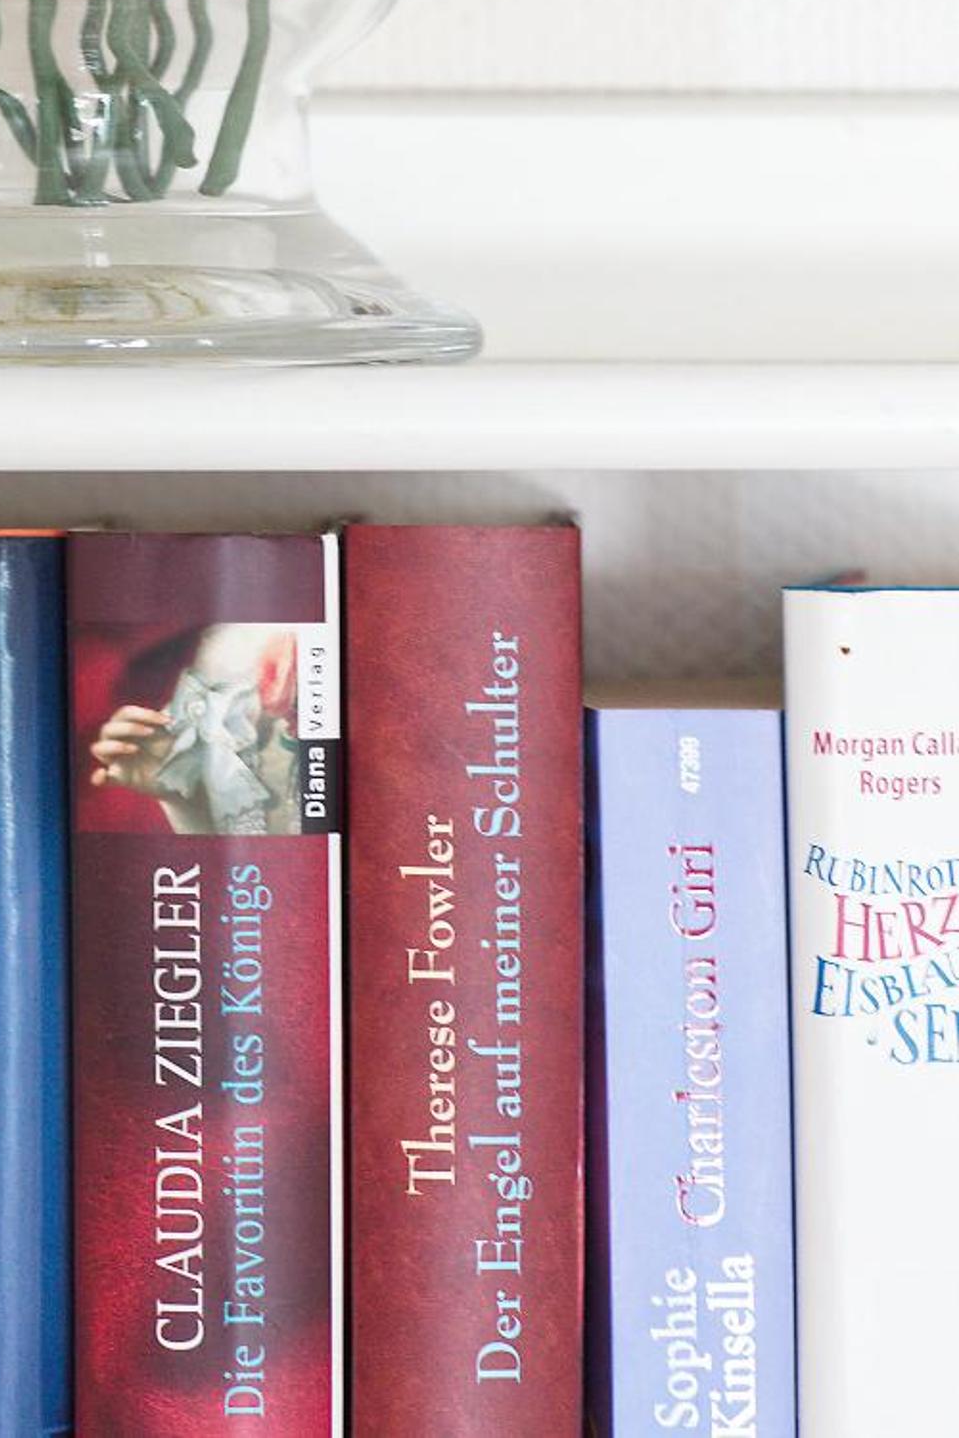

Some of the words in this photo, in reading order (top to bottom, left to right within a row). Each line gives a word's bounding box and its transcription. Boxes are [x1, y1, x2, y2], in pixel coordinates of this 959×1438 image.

[307, 646, 326, 731] Verlag
[464, 631, 523, 837] Schulter
[814, 731, 905, 761] Morgan
[912, 731, 959, 756] Call
[304, 745, 327, 819] Diana
[859, 770, 942, 800] Rogers
[153, 863, 203, 1087] ZIEGLER
[220, 863, 272, 1016] Königs
[398, 814, 457, 986] Fowler
[480, 852, 523, 1025] meiner
[221, 1033, 265, 1105] des
[399, 999, 456, 1196] Therese
[467, 1038, 522, 1118] auf
[154, 1101, 205, 1352] CLAUDIA
[222, 1124, 266, 1326] Favoritin
[467, 1132, 534, 1277] Engel
[223, 1345, 266, 1417] Die
[475, 1289, 522, 1385] Der
[650, 1266, 712, 1429] Sophie
[705, 1252, 758, 1438] Kinsella
